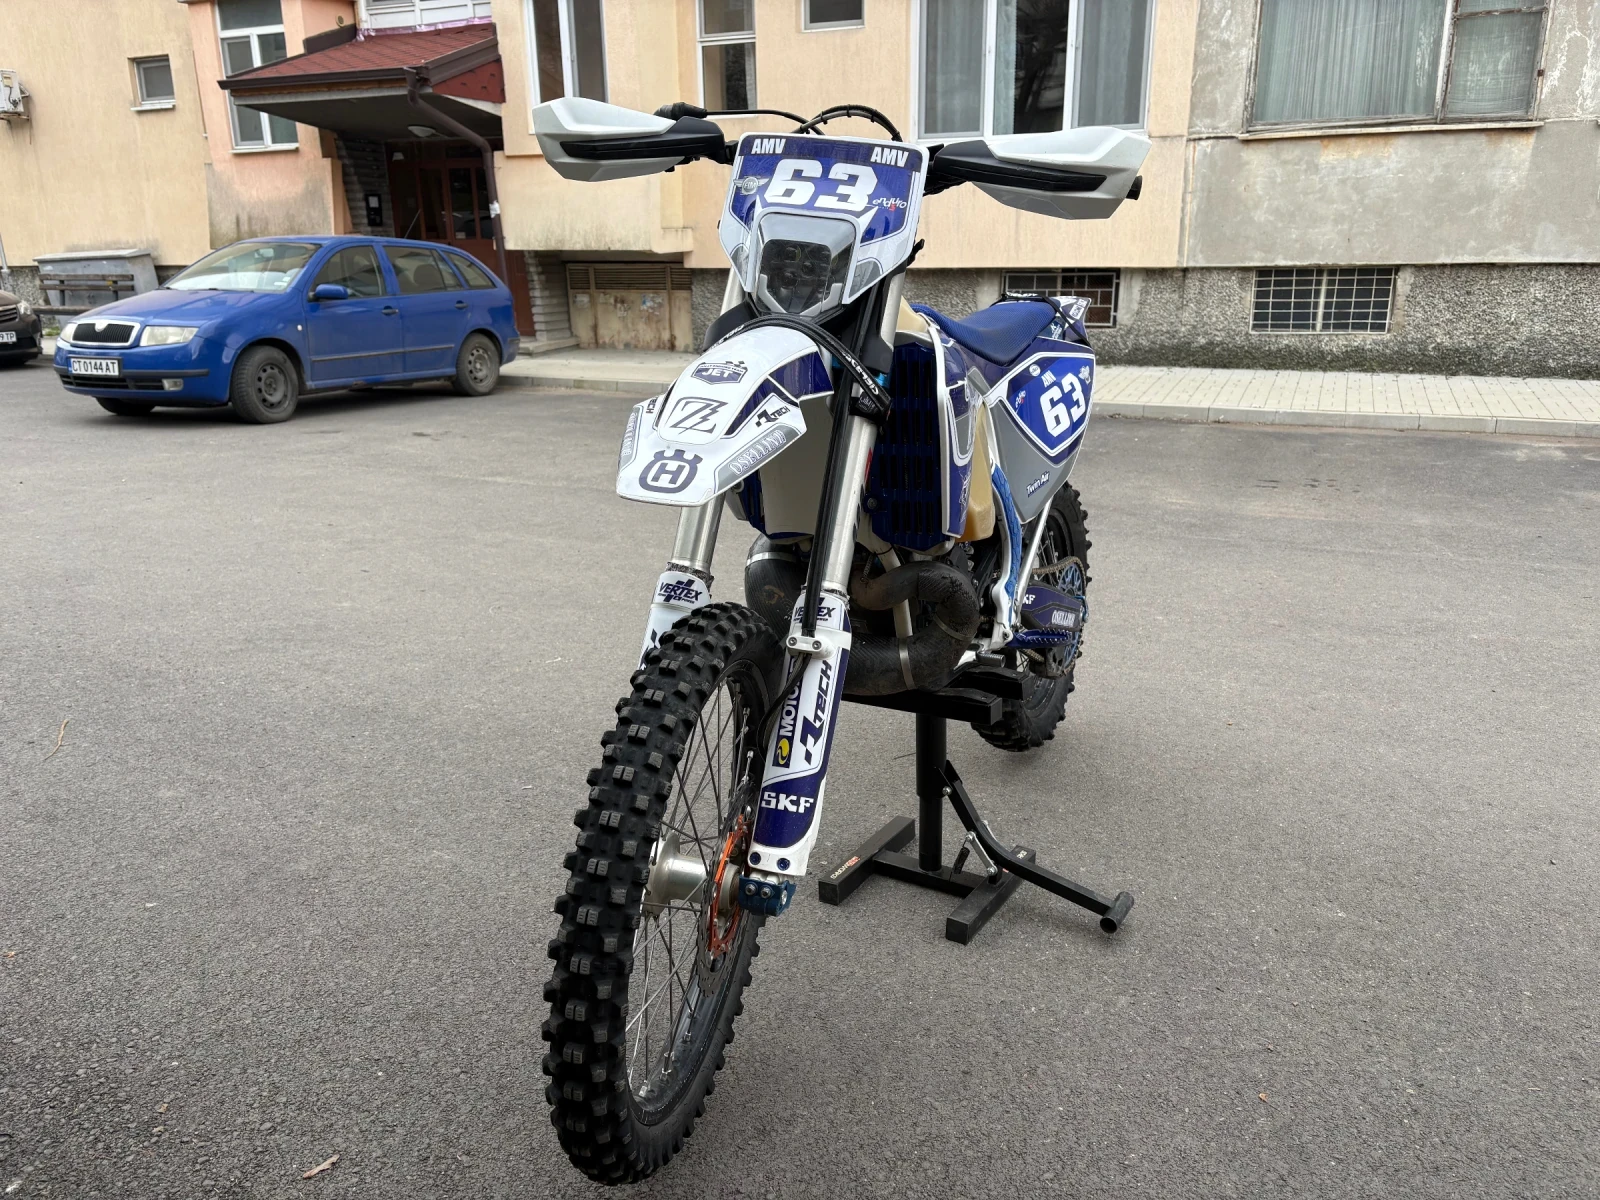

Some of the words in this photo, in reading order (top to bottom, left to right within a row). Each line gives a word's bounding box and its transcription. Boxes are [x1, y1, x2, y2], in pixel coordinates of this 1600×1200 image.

[751, 139, 786, 154] AMV
[870, 147, 909, 167] AMV
[763, 158, 878, 212] 63
[6, 332, 15, 340] TP
[72, 360, 82, 372] CT
[83, 361, 103, 373] 0144
[105, 361, 116, 373] AT
[701, 368, 733, 377] JET
[1040, 372, 1086, 437] 63
[1026, 479, 1041, 497] Twin
[1040, 470, 1050, 486] Air
[659, 582, 702, 601] VERTEX
[1022, 594, 1035, 604] KF
[795, 606, 836, 618] VEEX
[761, 791, 814, 814] SKF
